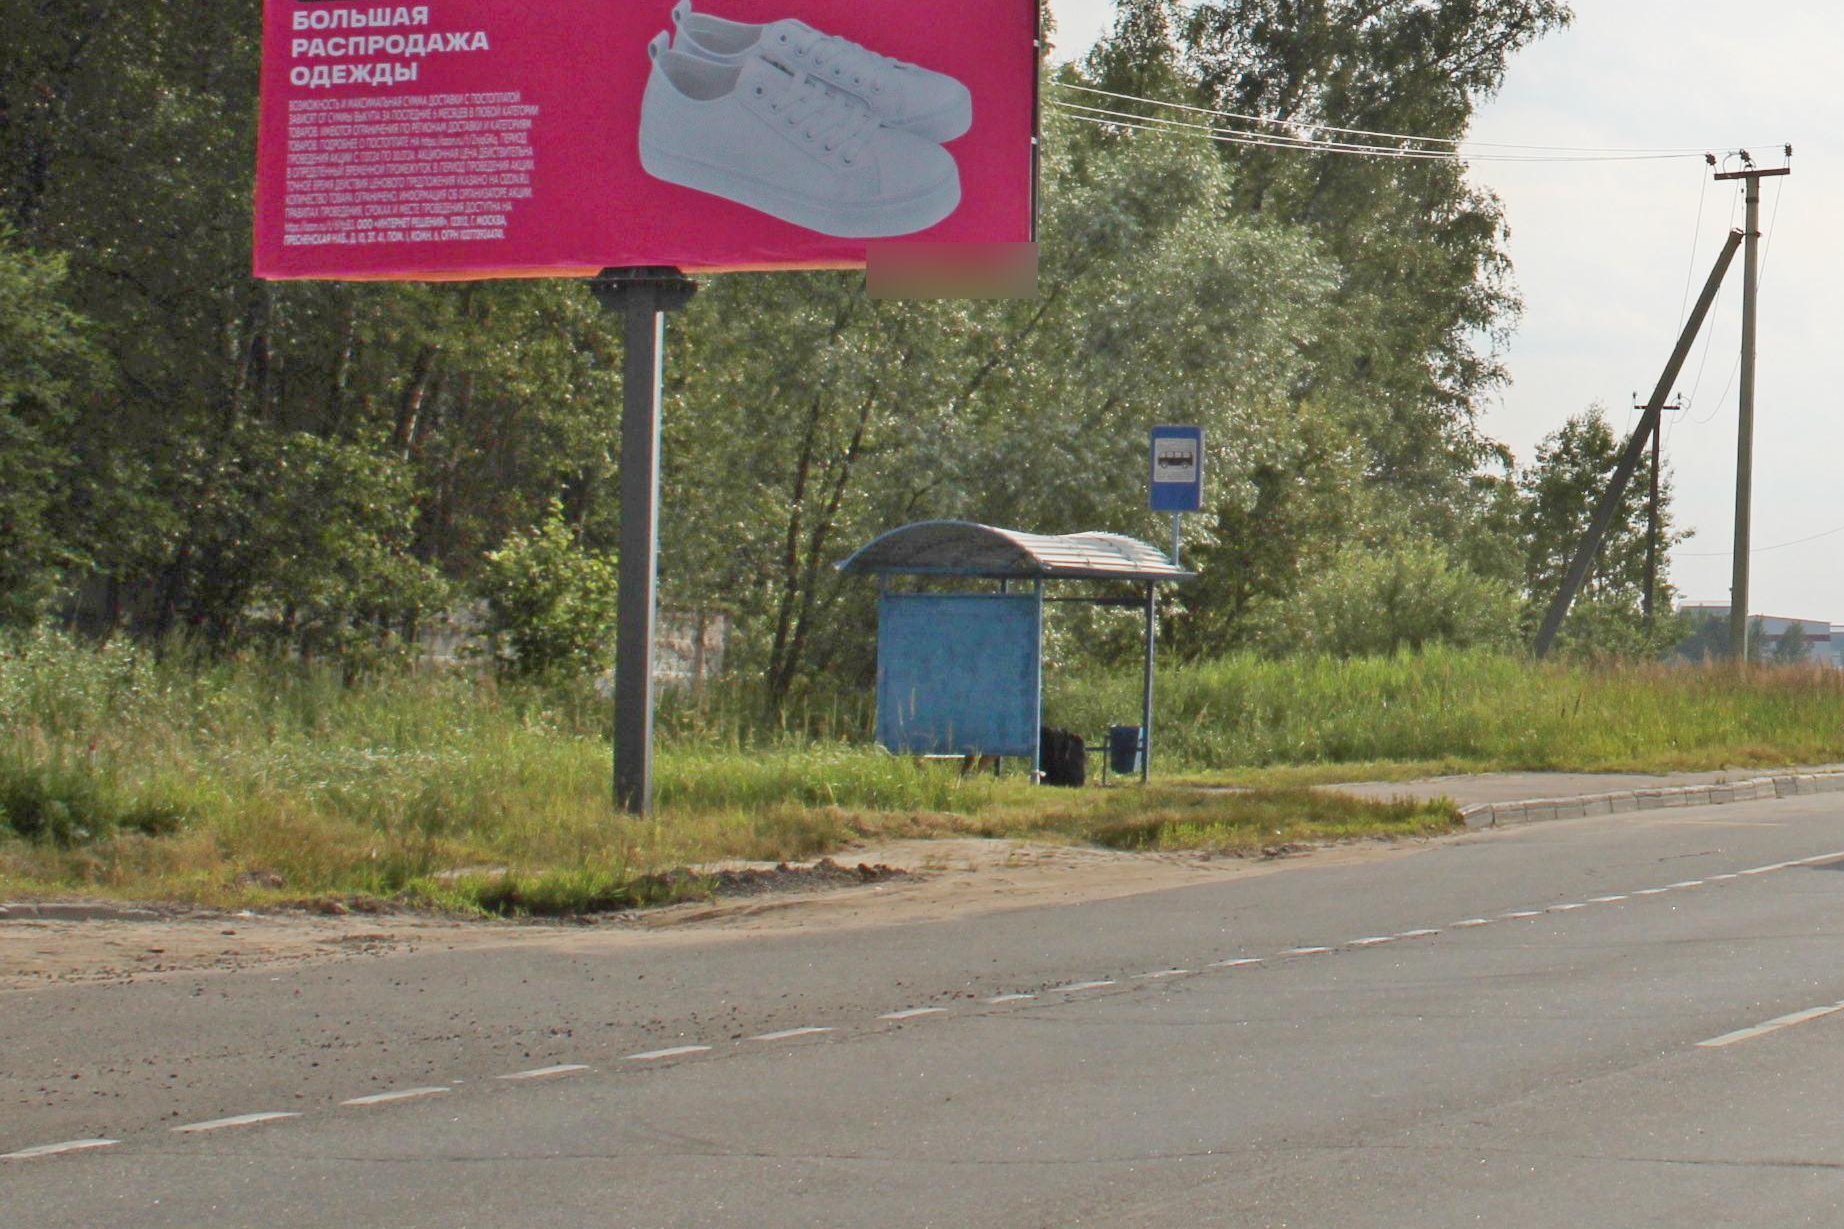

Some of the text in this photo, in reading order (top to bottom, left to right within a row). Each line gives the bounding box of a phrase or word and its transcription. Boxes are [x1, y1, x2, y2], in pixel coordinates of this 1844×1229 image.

[292, 6, 429, 31] БОЛЬШАЯ
[291, 31, 490, 58] РАСПРОДАЖА
[289, 62, 419, 89] ОДЕЖДЫ
